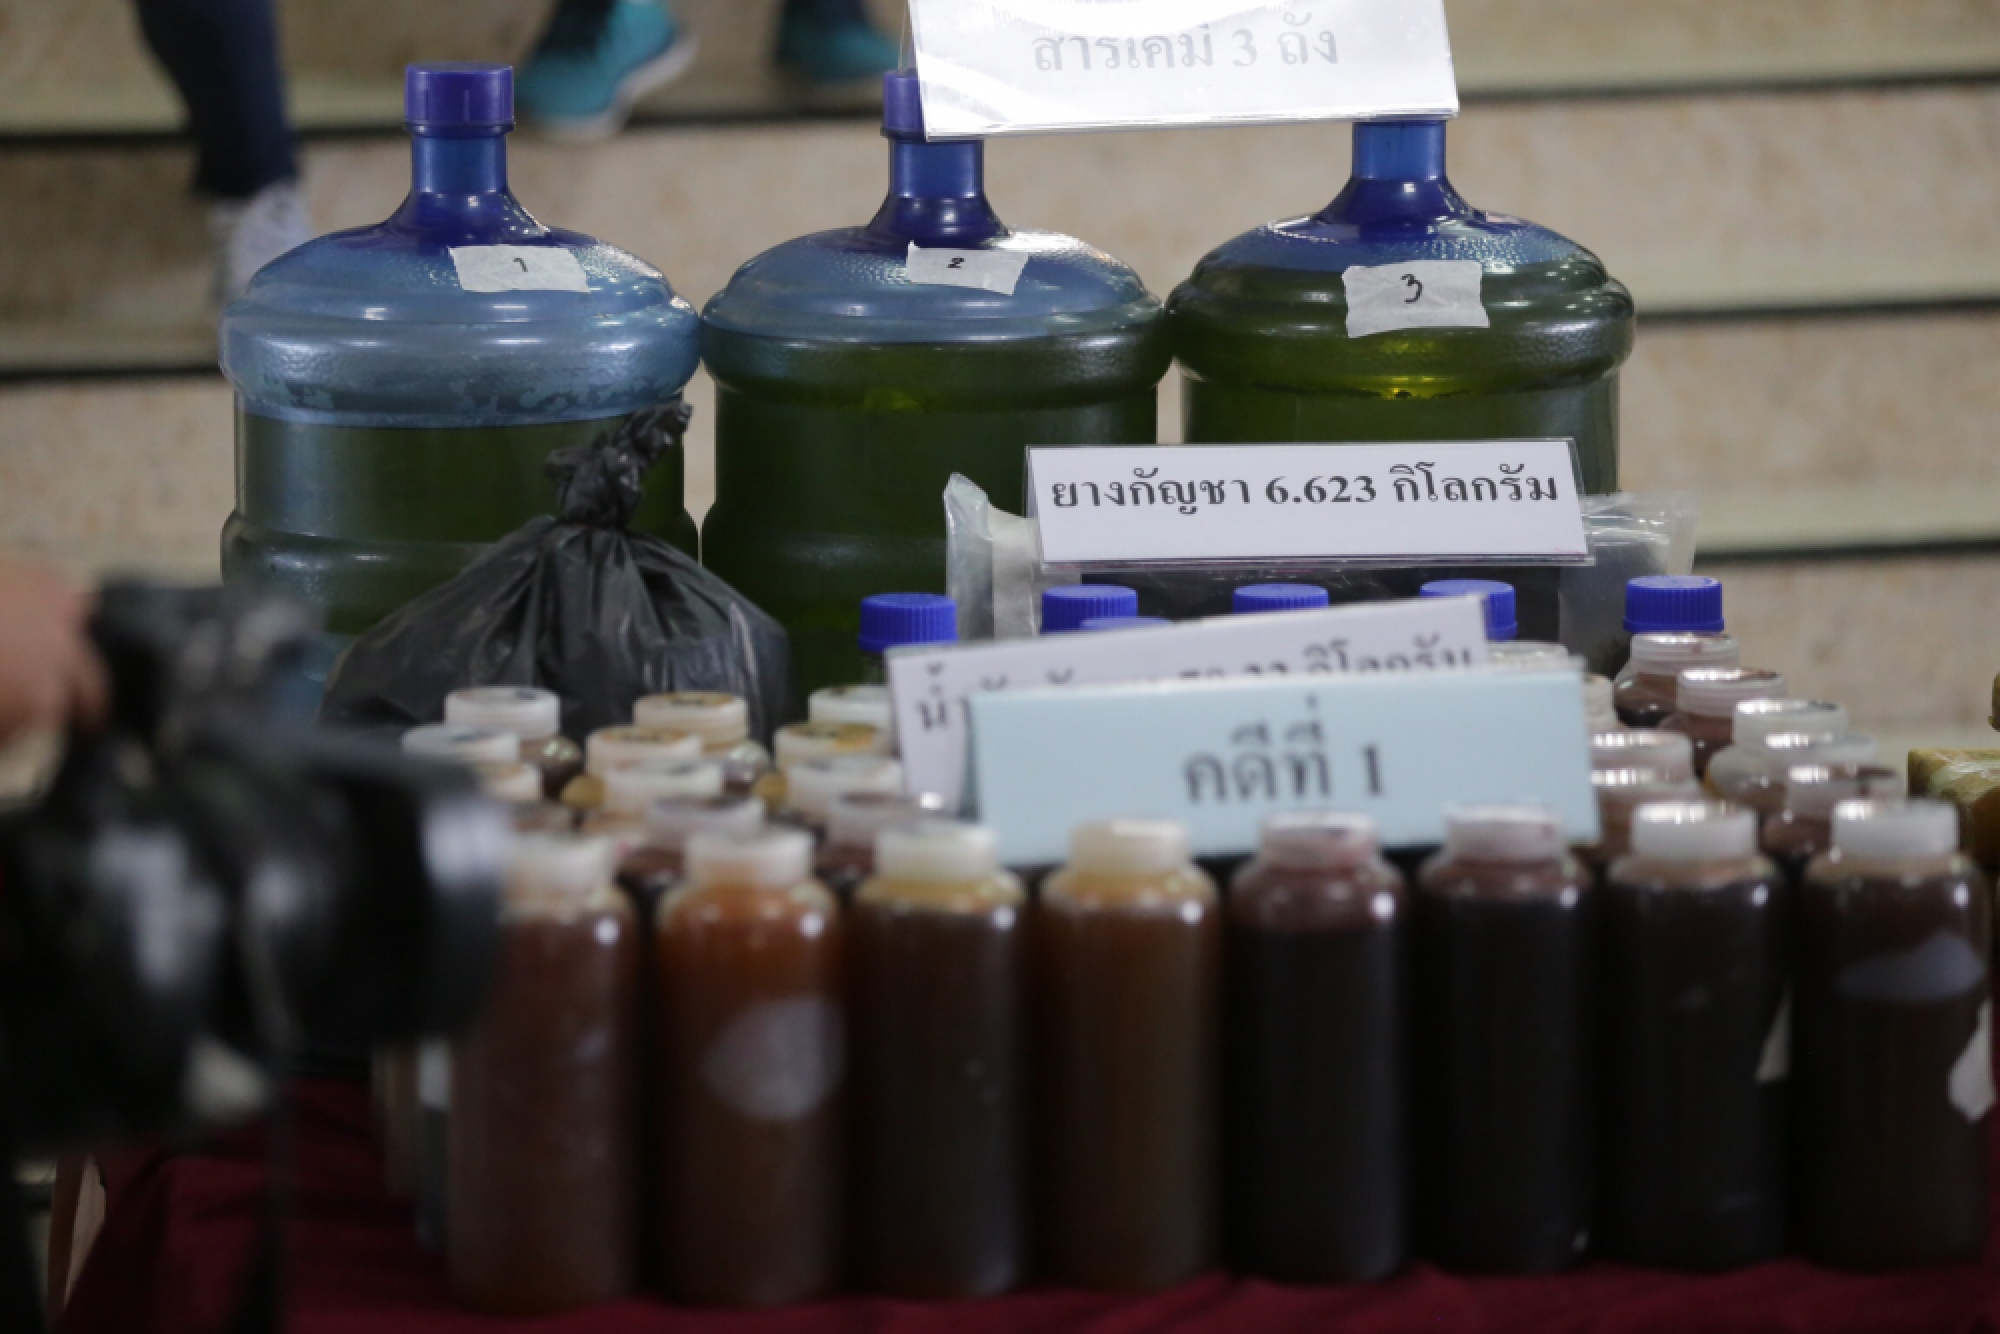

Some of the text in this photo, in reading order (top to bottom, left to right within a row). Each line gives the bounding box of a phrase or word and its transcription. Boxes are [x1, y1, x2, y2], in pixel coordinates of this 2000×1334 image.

[1231, 27, 1258, 67] 3
[1275, 11, 1339, 65] ถัง
[947, 256, 966, 269] 2
[1401, 273, 1423, 304] 3
[1051, 461, 1559, 515] ยางกัญชา 6.623 กิโลกรัม
[1180, 692, 1383, 803] คดีที่ 1
